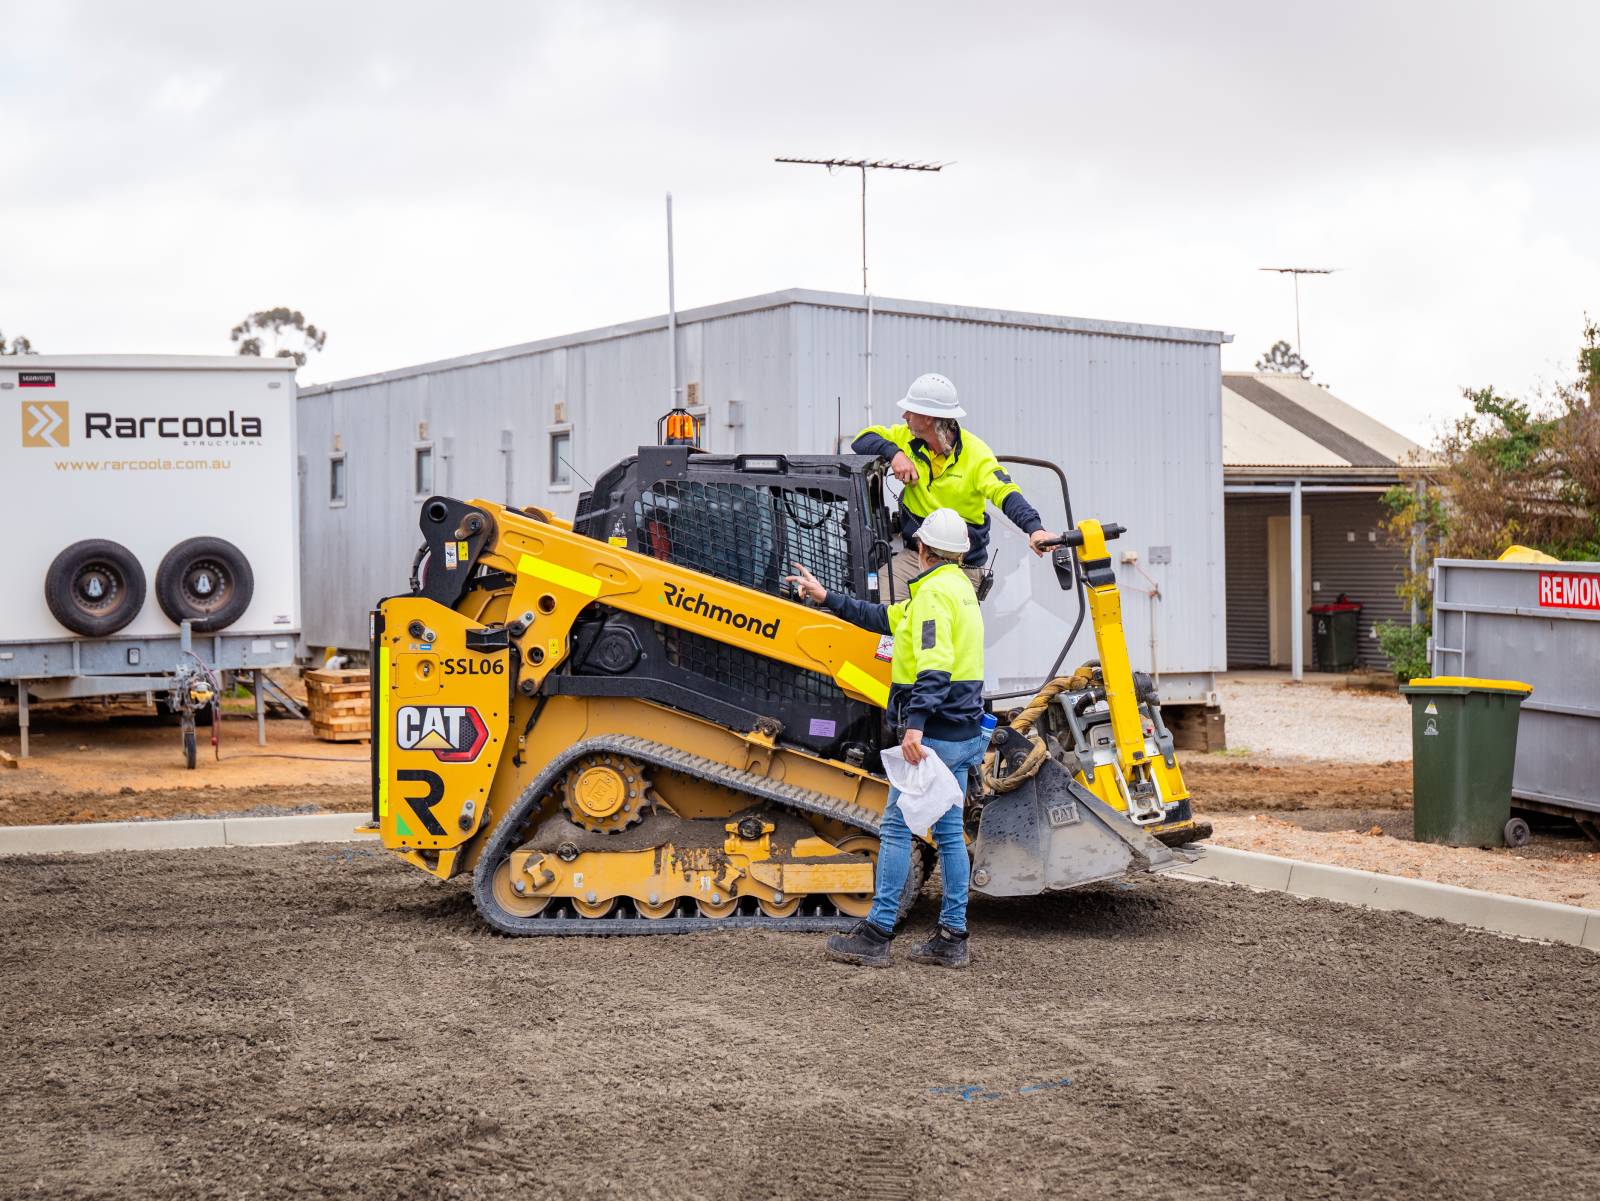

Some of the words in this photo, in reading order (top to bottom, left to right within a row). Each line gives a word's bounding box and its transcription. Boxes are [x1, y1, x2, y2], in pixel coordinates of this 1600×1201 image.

[85, 410, 262, 438] Rarcoola
[54, 458, 231, 471] www.rarcoola.com.au
[662, 581, 781, 640] Richmond
[443, 658, 504, 675] SSL06
[397, 706, 466, 750] CAT
[397, 769, 448, 836] R
[1051, 805, 1074, 824] CAT
